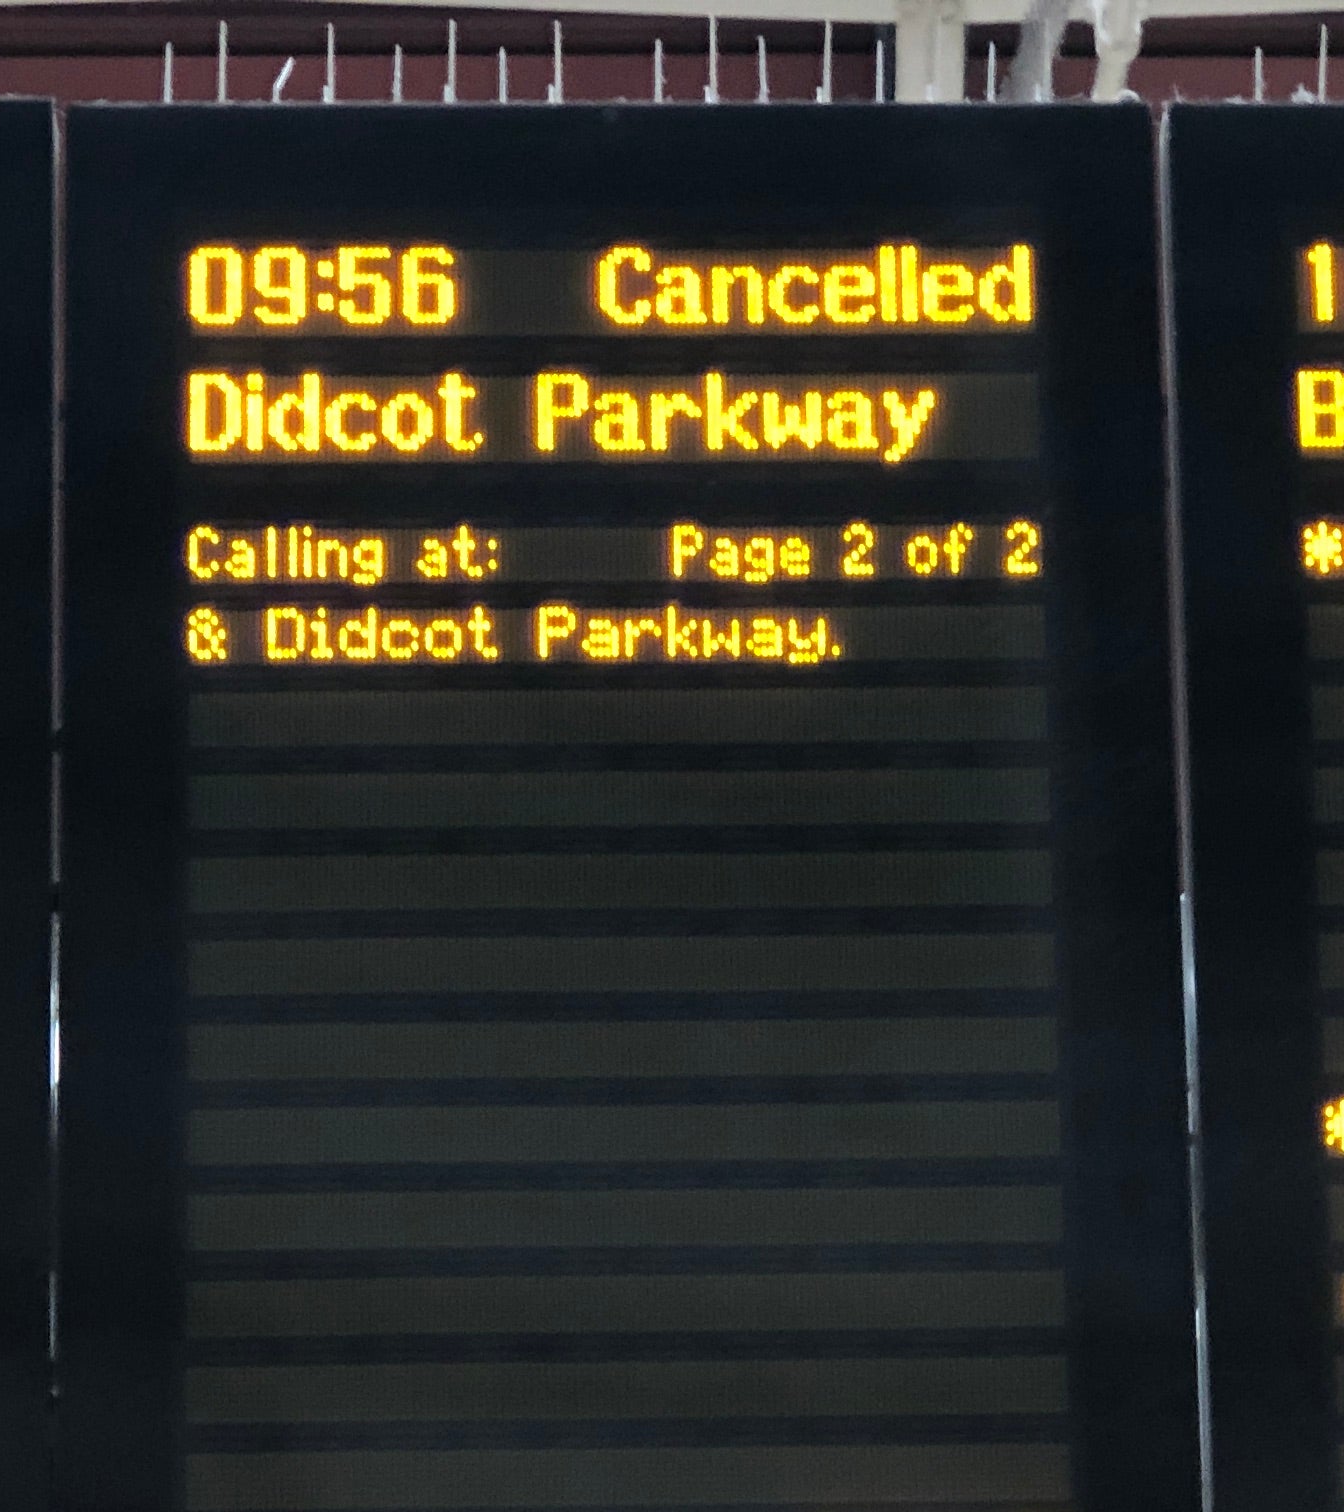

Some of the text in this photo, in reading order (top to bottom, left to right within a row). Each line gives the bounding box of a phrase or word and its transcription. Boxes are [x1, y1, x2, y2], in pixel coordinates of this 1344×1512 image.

[187, 243, 1034, 328] 09:56 Cancelled
[187, 371, 938, 464] Didcot Parkway
[186, 520, 1039, 587] Calling at: Page 2 of 2
[186, 604, 842, 665] & Didcot Parkway.
